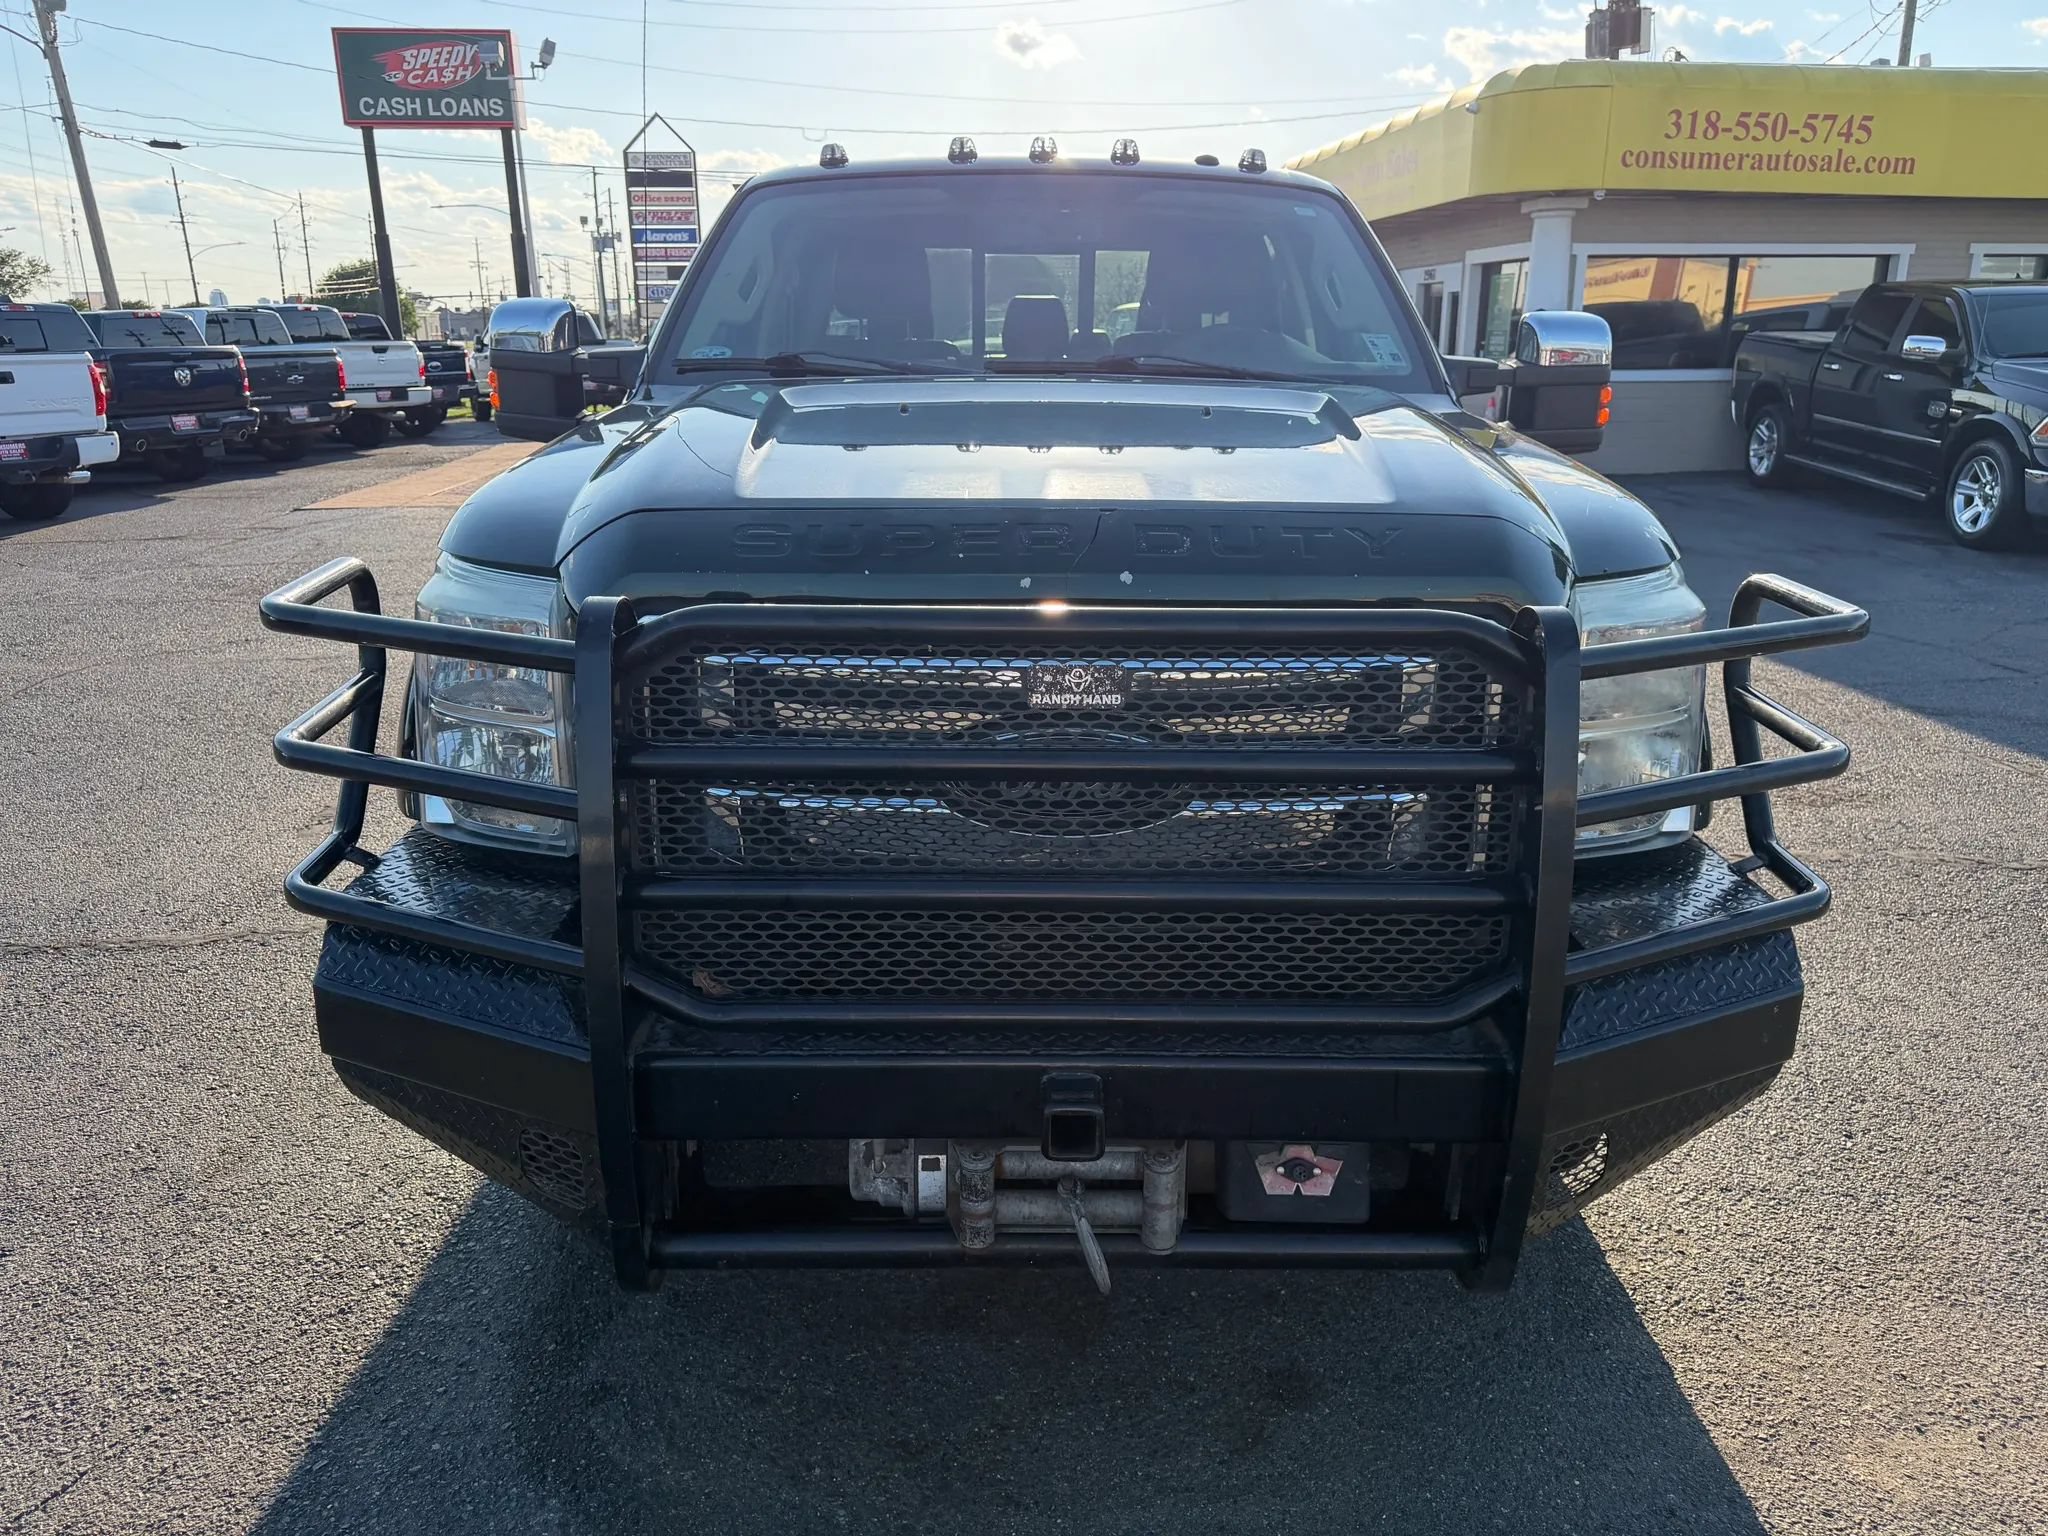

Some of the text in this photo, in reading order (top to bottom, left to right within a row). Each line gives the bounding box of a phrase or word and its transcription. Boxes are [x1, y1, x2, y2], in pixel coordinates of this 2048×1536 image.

[401, 45, 479, 70] SPEEDY
[407, 66, 473, 84] CA$H
[359, 97, 504, 117] CASH LOANS
[1663, 109, 1874, 144] 318-550-5745
[1620, 148, 1916, 175] consumerautosale.com
[642, 230, 689, 241] Aaron's
[733, 523, 1404, 558] SUPER DUTY
[1032, 694, 1121, 706] RANCH HAND
